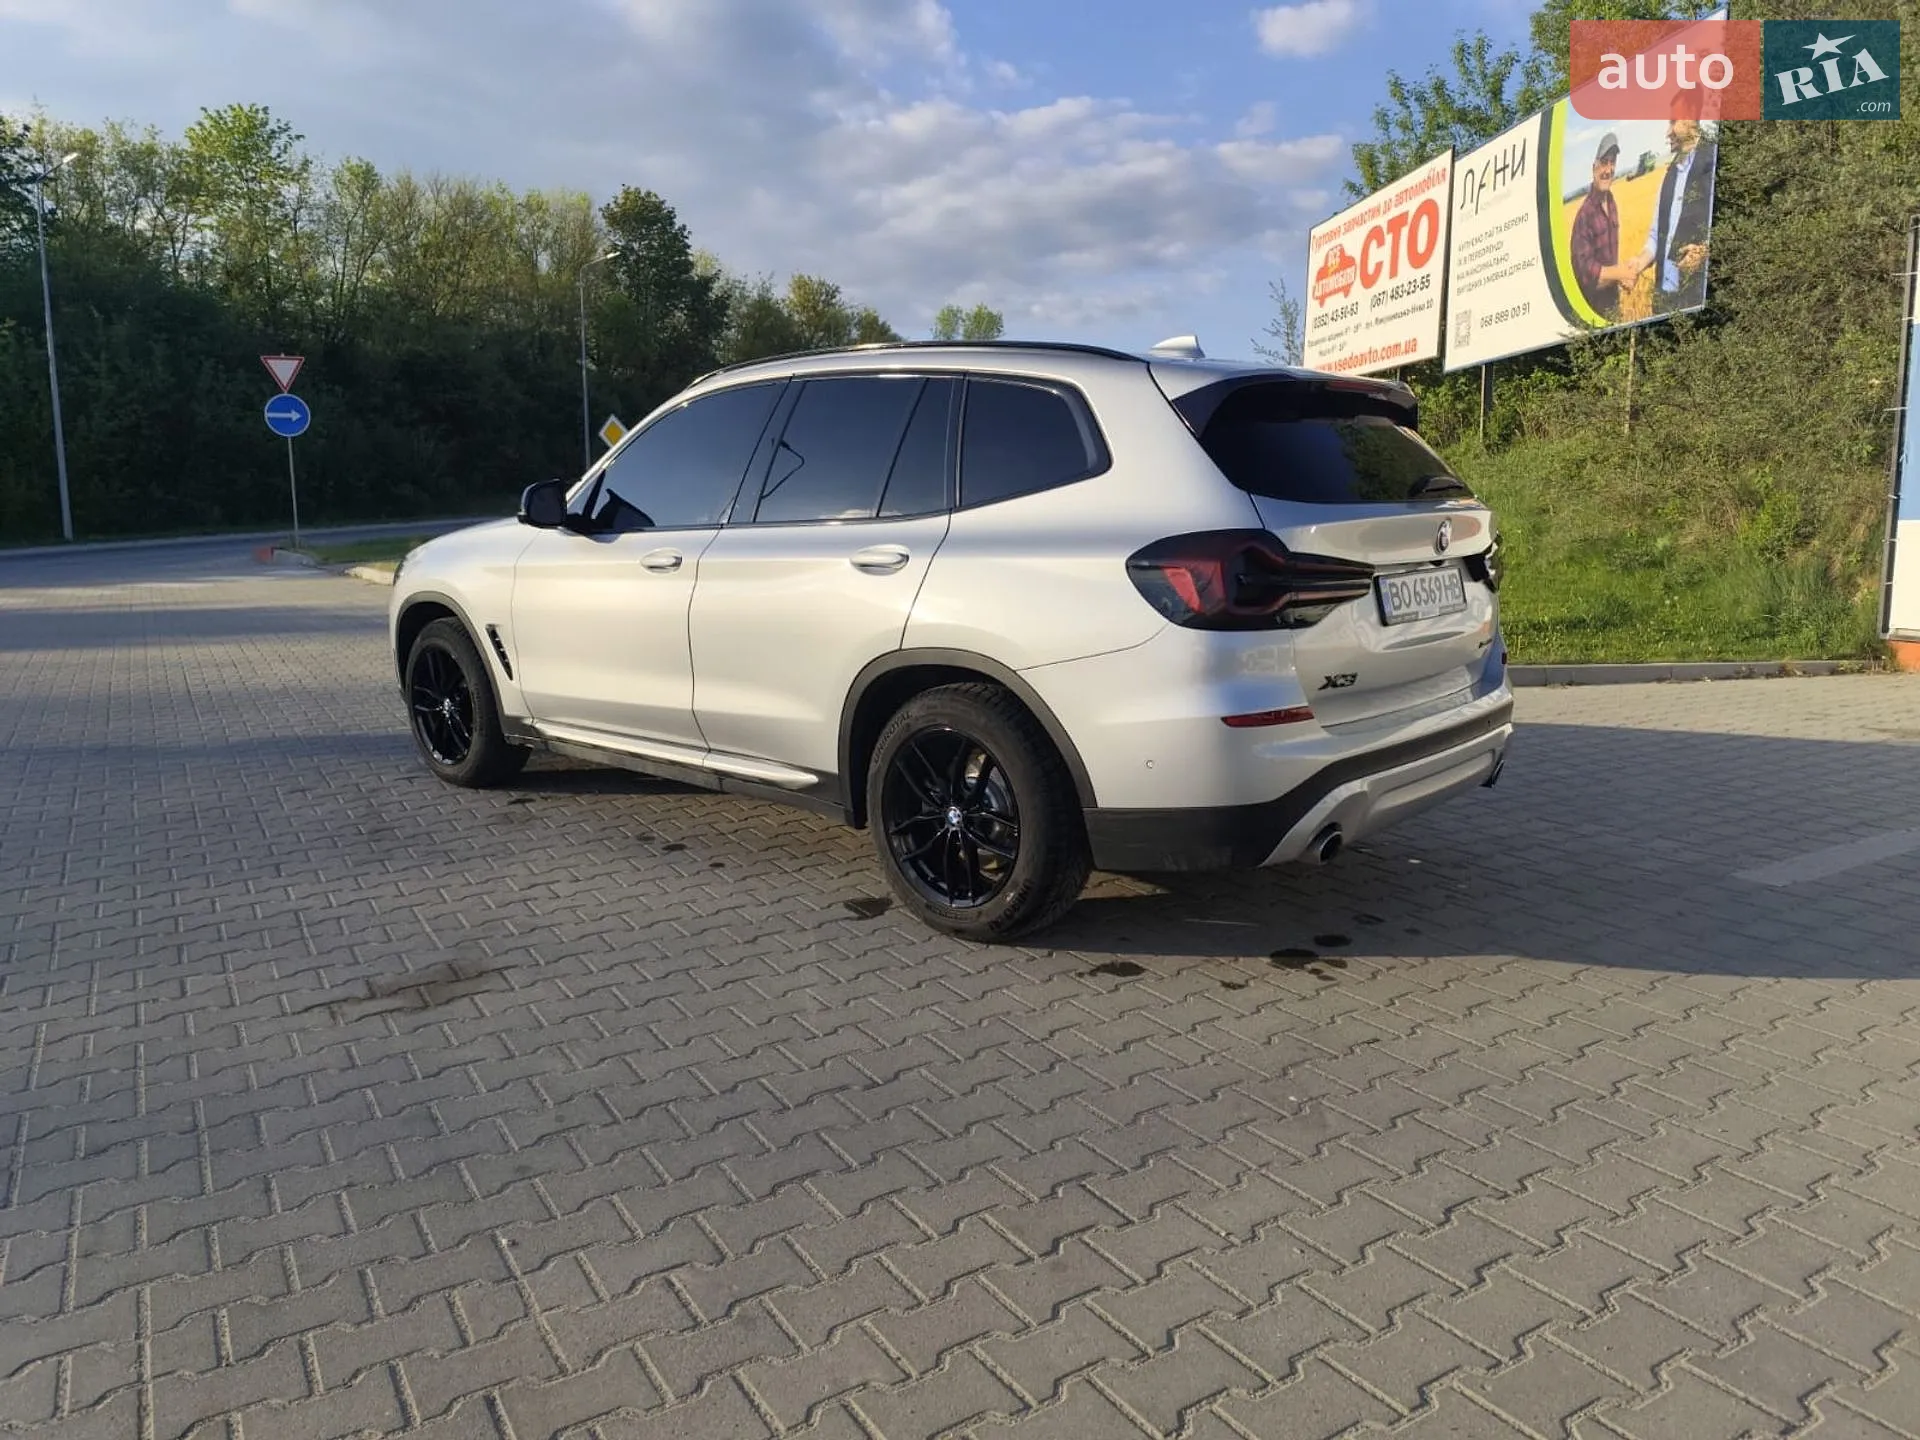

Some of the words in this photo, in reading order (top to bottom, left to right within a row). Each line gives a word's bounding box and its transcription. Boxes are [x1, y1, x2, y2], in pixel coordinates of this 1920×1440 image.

[1394, 167, 1447, 207] автомобіля
[1360, 198, 1440, 289] СТО
[1414, 576, 1443, 605] 6569
[1318, 672, 1358, 690] X3
